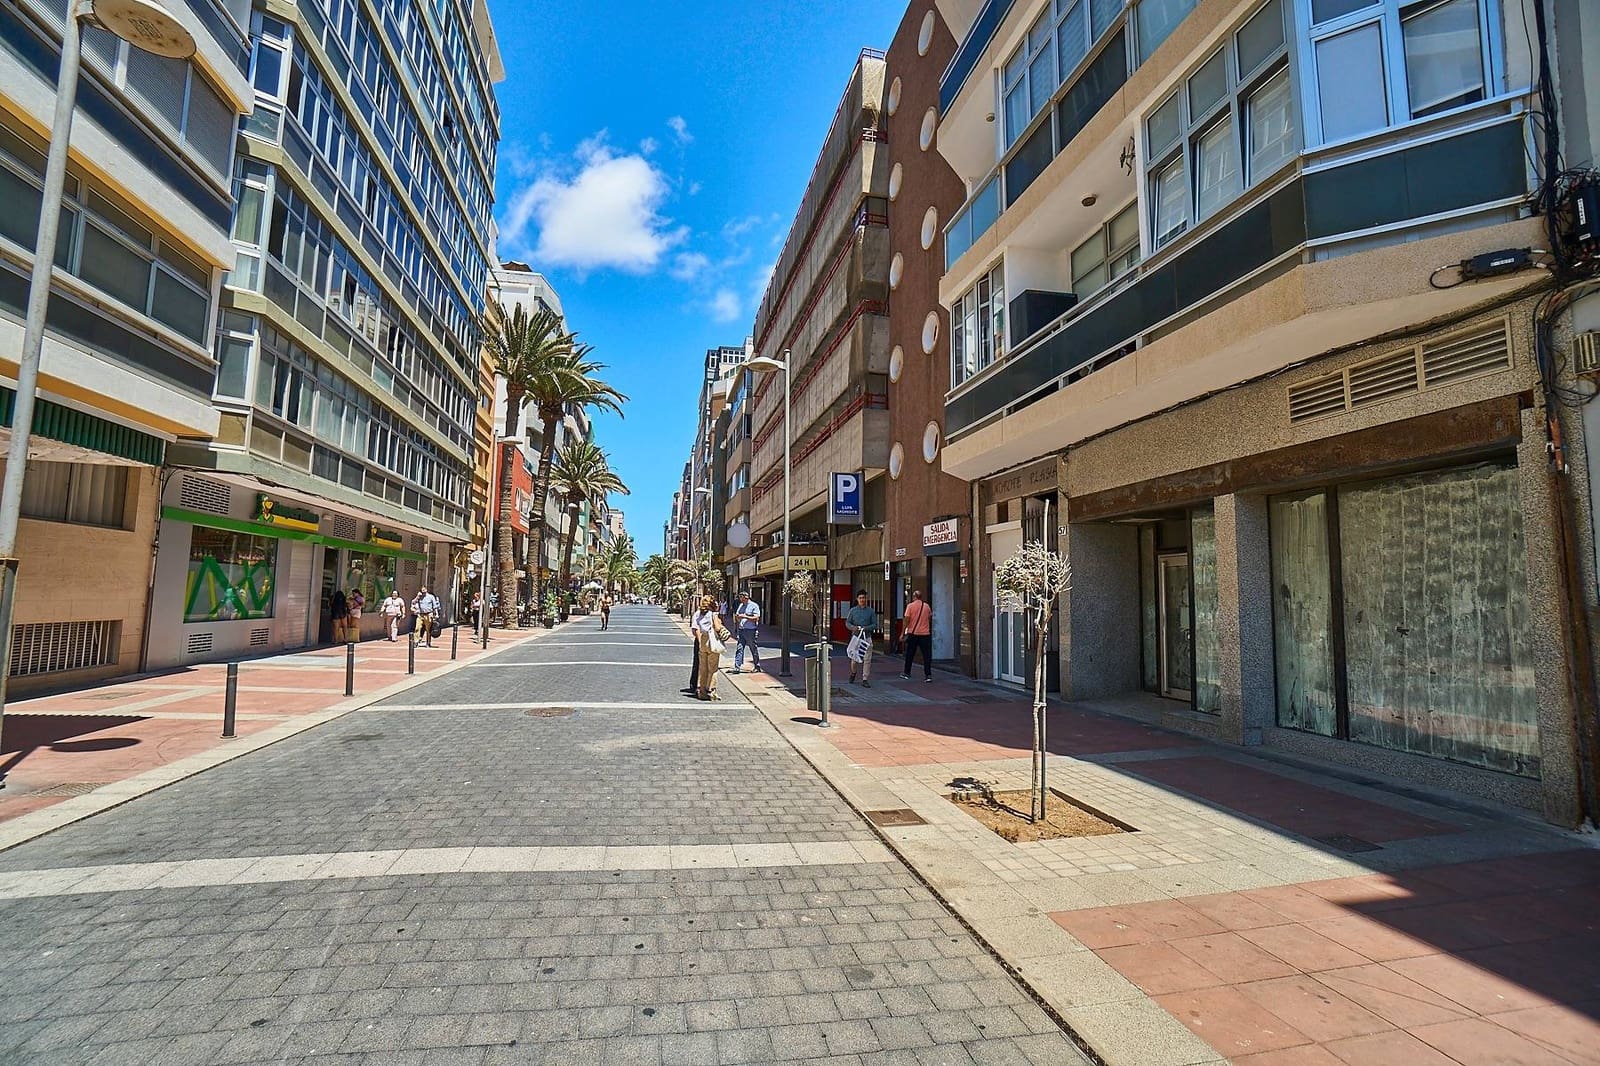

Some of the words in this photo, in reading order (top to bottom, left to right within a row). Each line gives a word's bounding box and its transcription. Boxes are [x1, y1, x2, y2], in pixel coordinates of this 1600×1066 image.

[837, 474, 857, 502] P
[930, 522, 950, 534] SALIDA
[1058, 526, 1067, 535] 57
[924, 530, 957, 545] EMERGENCIA
